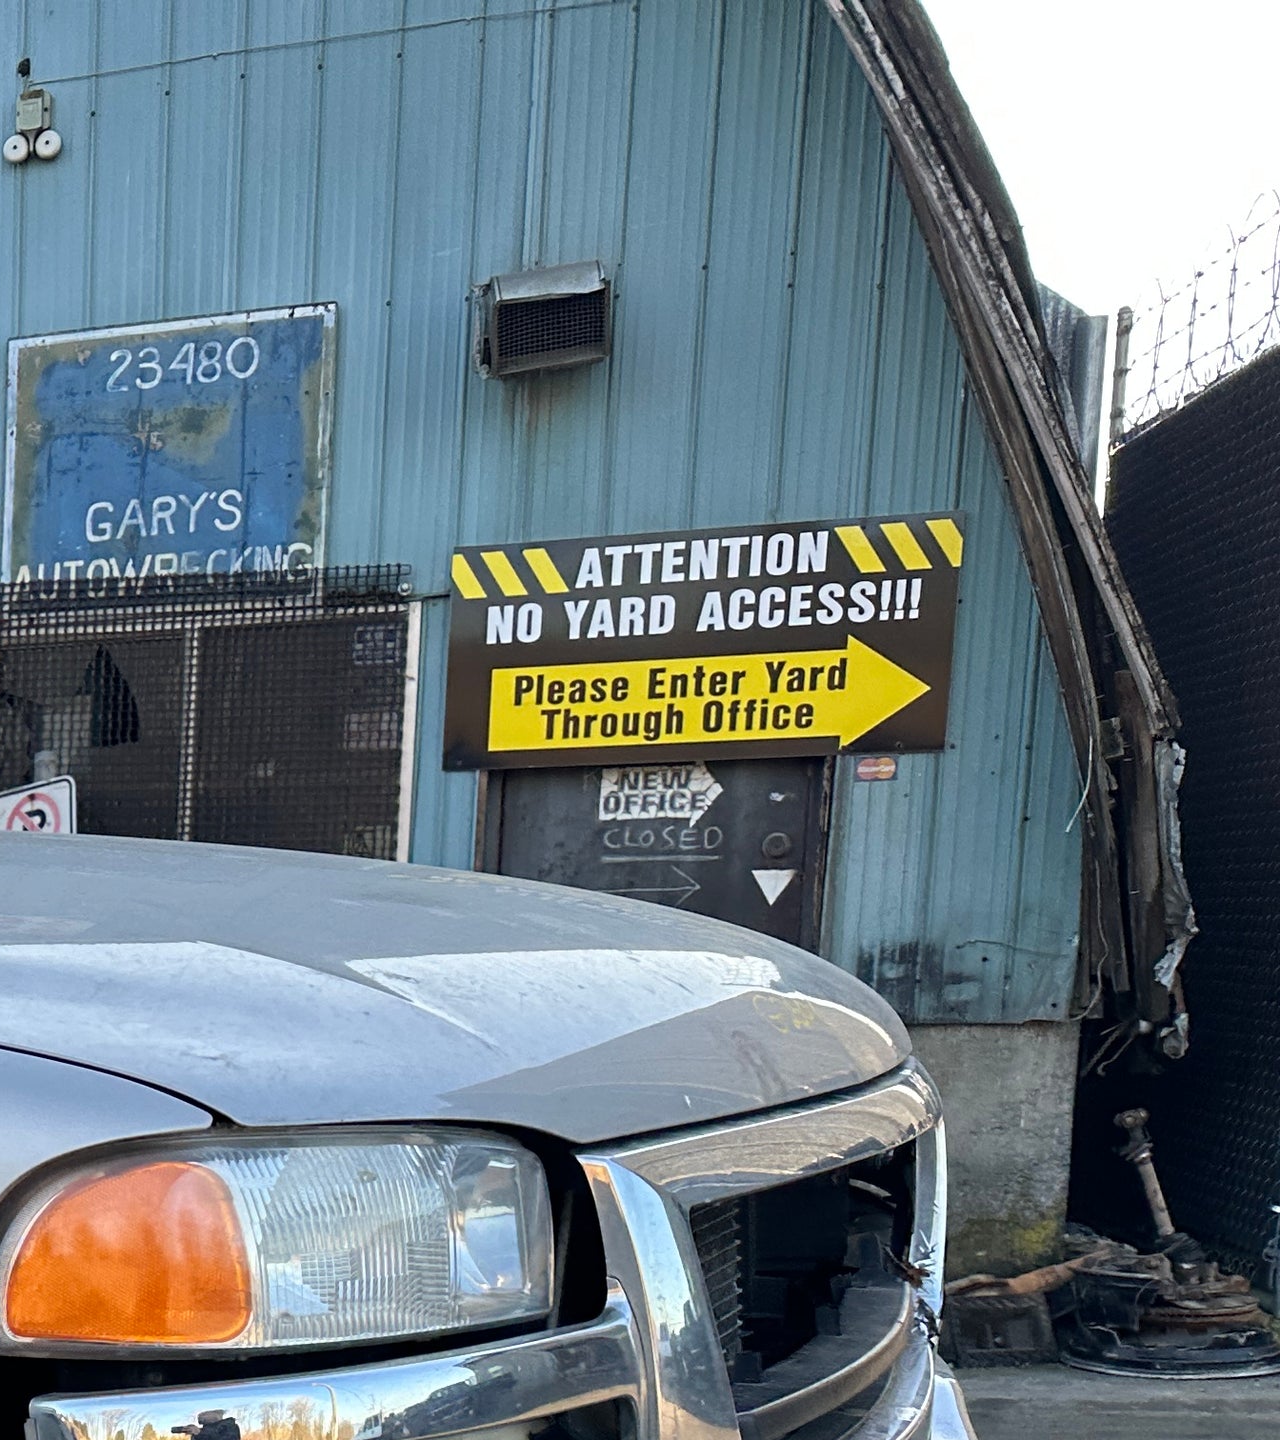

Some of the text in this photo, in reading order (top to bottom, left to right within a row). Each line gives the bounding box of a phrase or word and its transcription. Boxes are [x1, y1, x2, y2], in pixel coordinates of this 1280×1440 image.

[106, 336, 260, 392] 23480
[85, 489, 243, 542] GARY'S
[575, 531, 829, 588] ATTENTION
[486, 578, 923, 645] NO YARD ACCESS!!!
[513, 658, 848, 706] Please Enter Yard
[540, 697, 815, 741] Through Office
[603, 791, 708, 814] OFFICE
[618, 768, 692, 791] NEW
[603, 825, 723, 850] CLOSED
